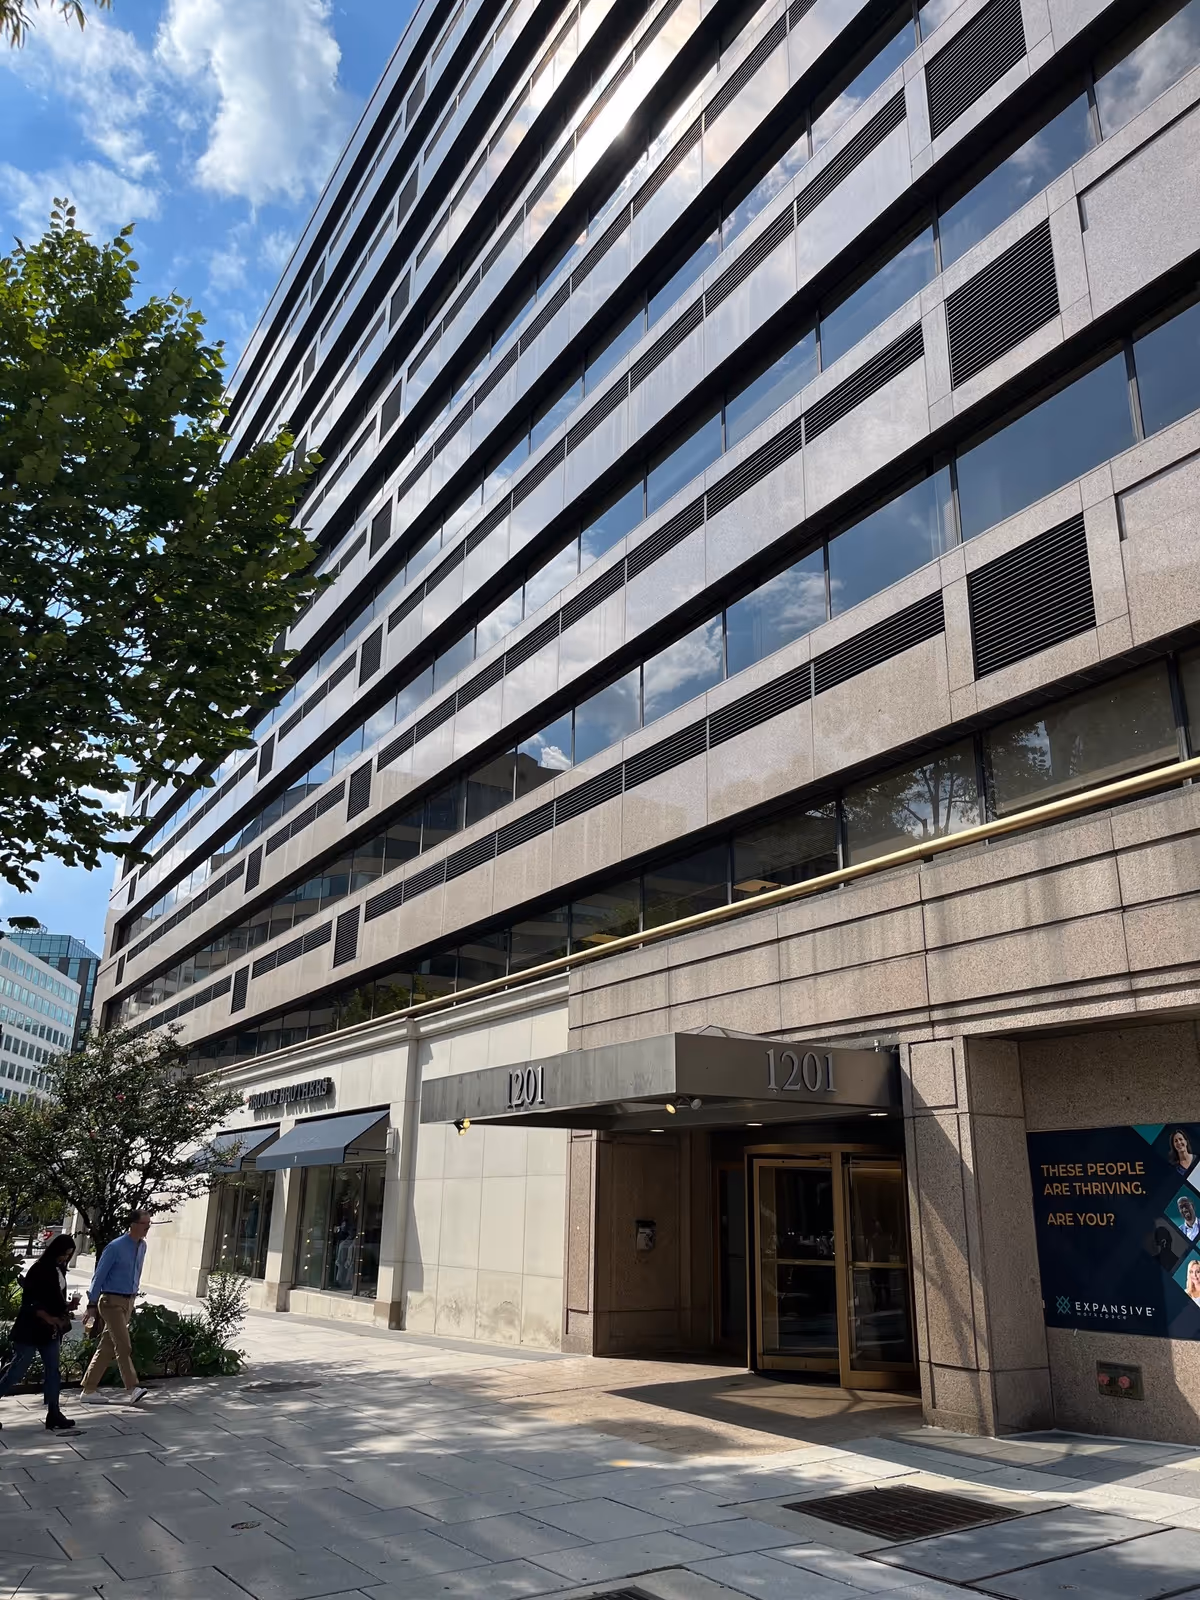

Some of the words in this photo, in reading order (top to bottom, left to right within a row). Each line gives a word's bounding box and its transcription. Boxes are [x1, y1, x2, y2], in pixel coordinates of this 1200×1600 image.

[766, 1047, 838, 1093] 1201
[279, 1078, 328, 1103] BROTHERS
[507, 1065, 546, 1110] 1201
[1040, 1163, 1084, 1177] THESE
[1087, 1161, 1145, 1176] PEOPLE
[1043, 1182, 1070, 1196] ARE
[1073, 1181, 1146, 1196] THRIVING.
[1047, 1213, 1074, 1226] ARE
[1076, 1212, 1115, 1226] YOU?
[1075, 1302, 1153, 1317] EXPANSIVE
